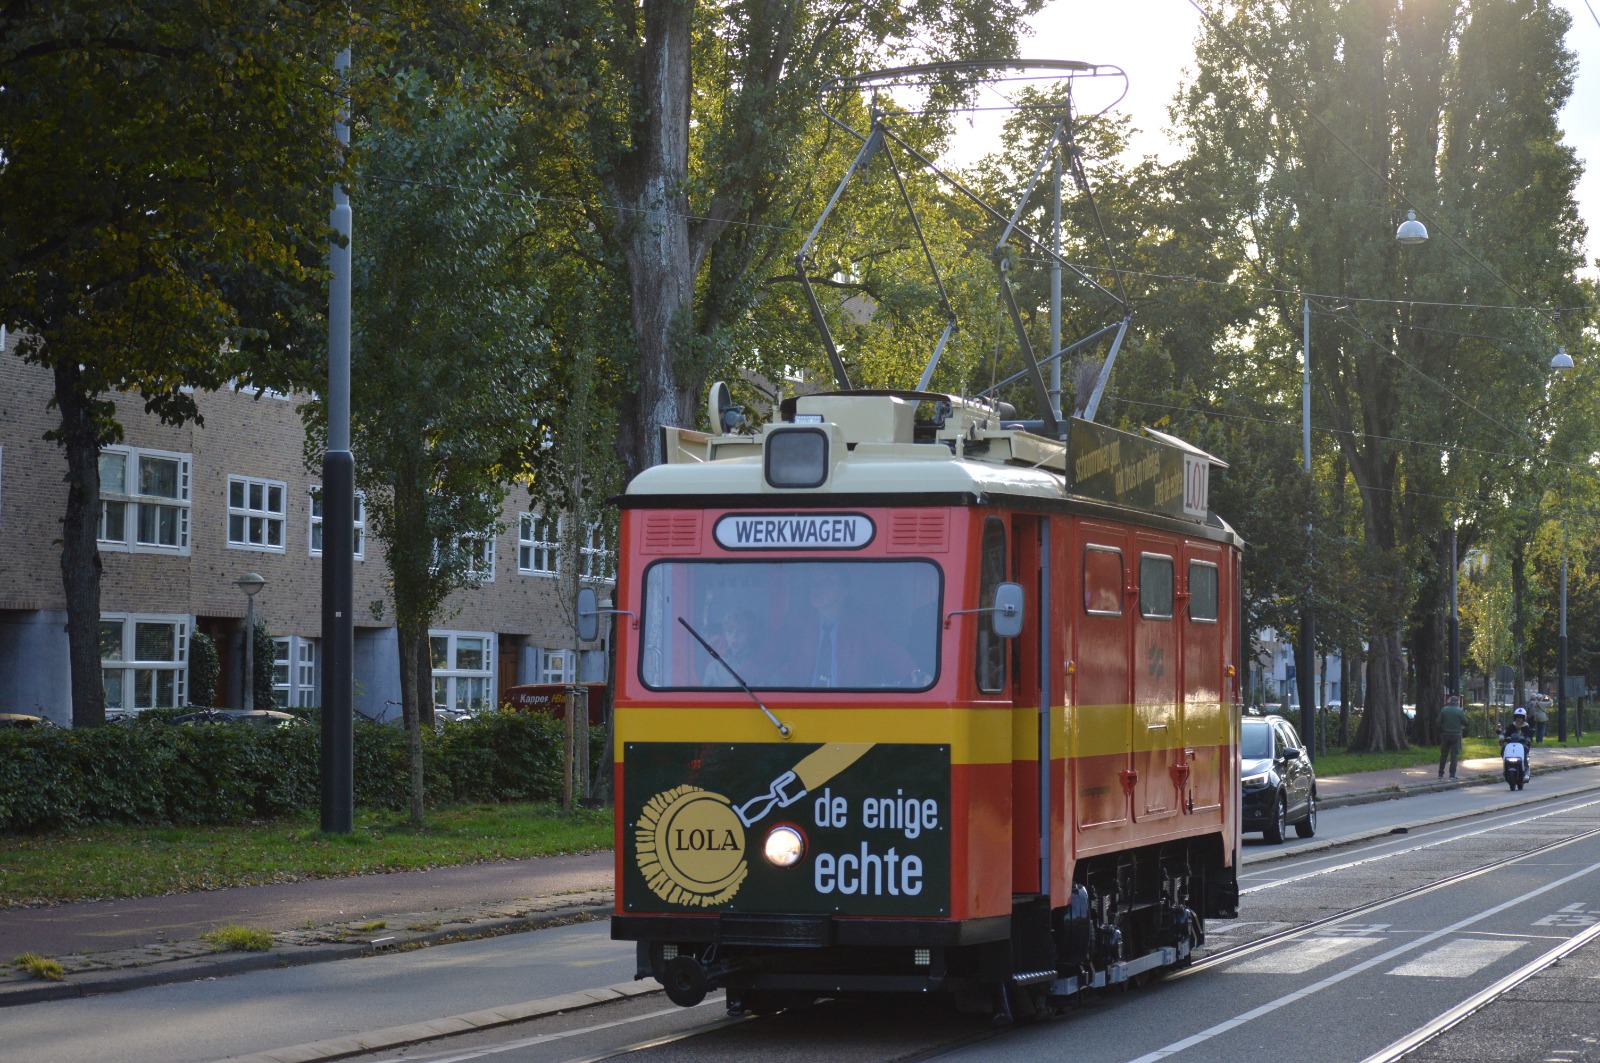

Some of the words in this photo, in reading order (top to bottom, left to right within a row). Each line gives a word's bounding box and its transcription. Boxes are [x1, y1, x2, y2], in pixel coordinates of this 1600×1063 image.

[735, 519, 856, 543] WERKWAGEN
[520, 694, 549, 704] Kapper
[814, 788, 847, 828] de
[863, 789, 938, 839] enige
[675, 829, 740, 851] LOLA
[814, 841, 923, 896] echte
